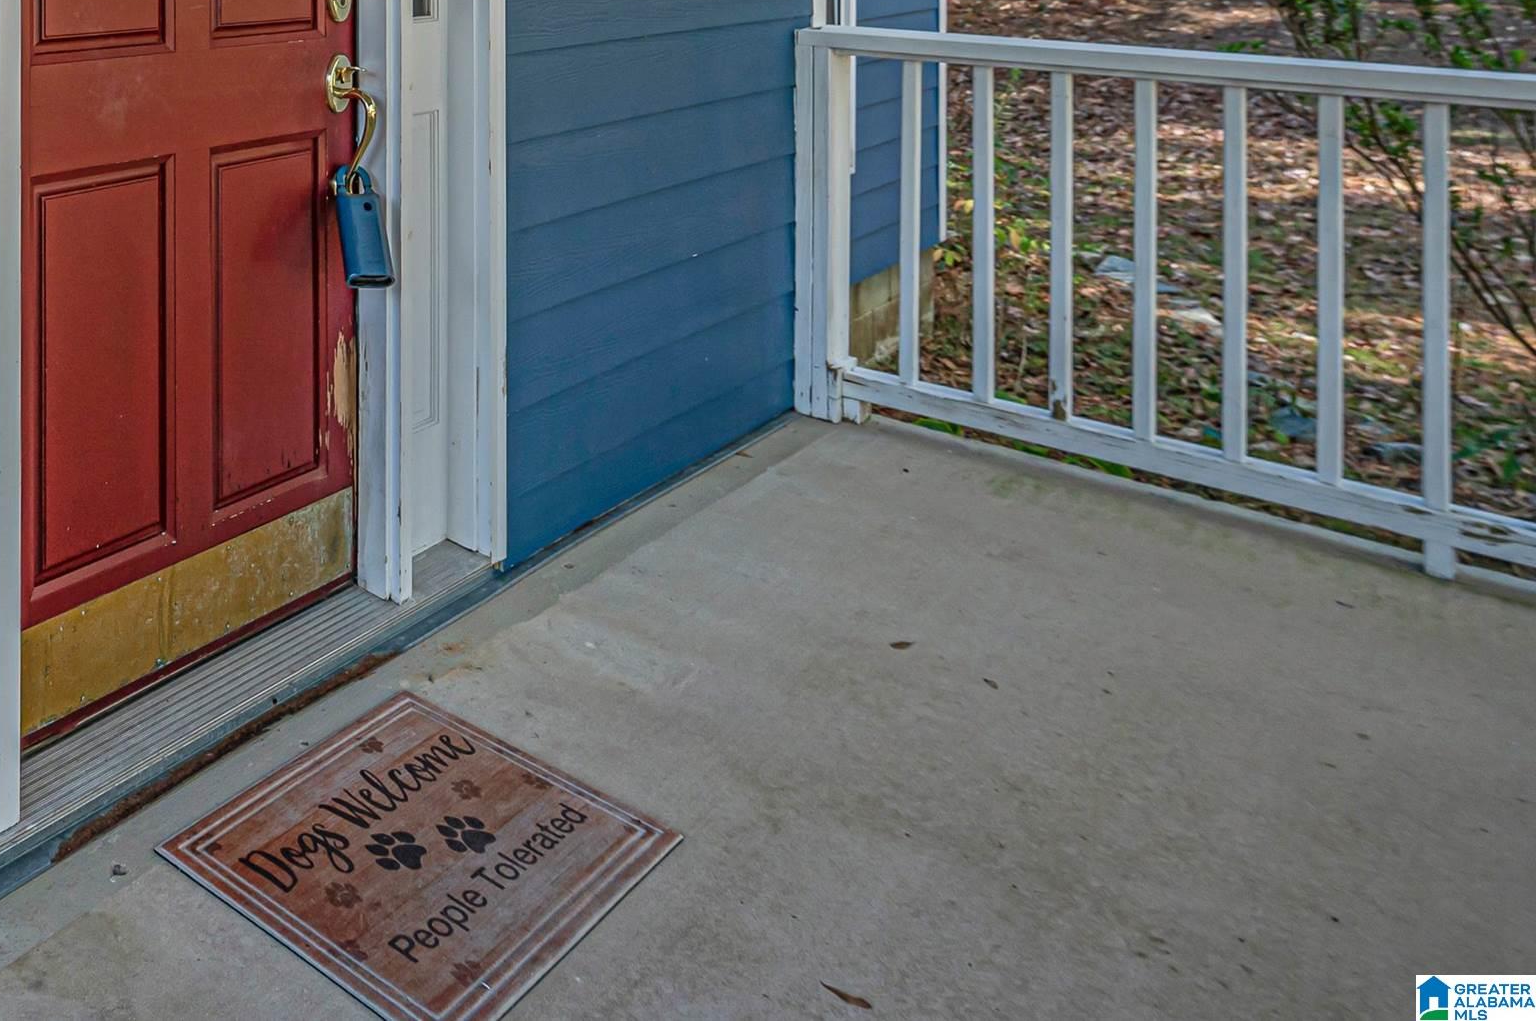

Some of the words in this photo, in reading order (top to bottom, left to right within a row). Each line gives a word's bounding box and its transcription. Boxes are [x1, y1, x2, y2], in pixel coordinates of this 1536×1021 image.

[238, 821, 356, 894] Dogs
[319, 733, 476, 828] Welcome
[387, 889, 488, 964] People
[470, 803, 588, 891] Tolerated
